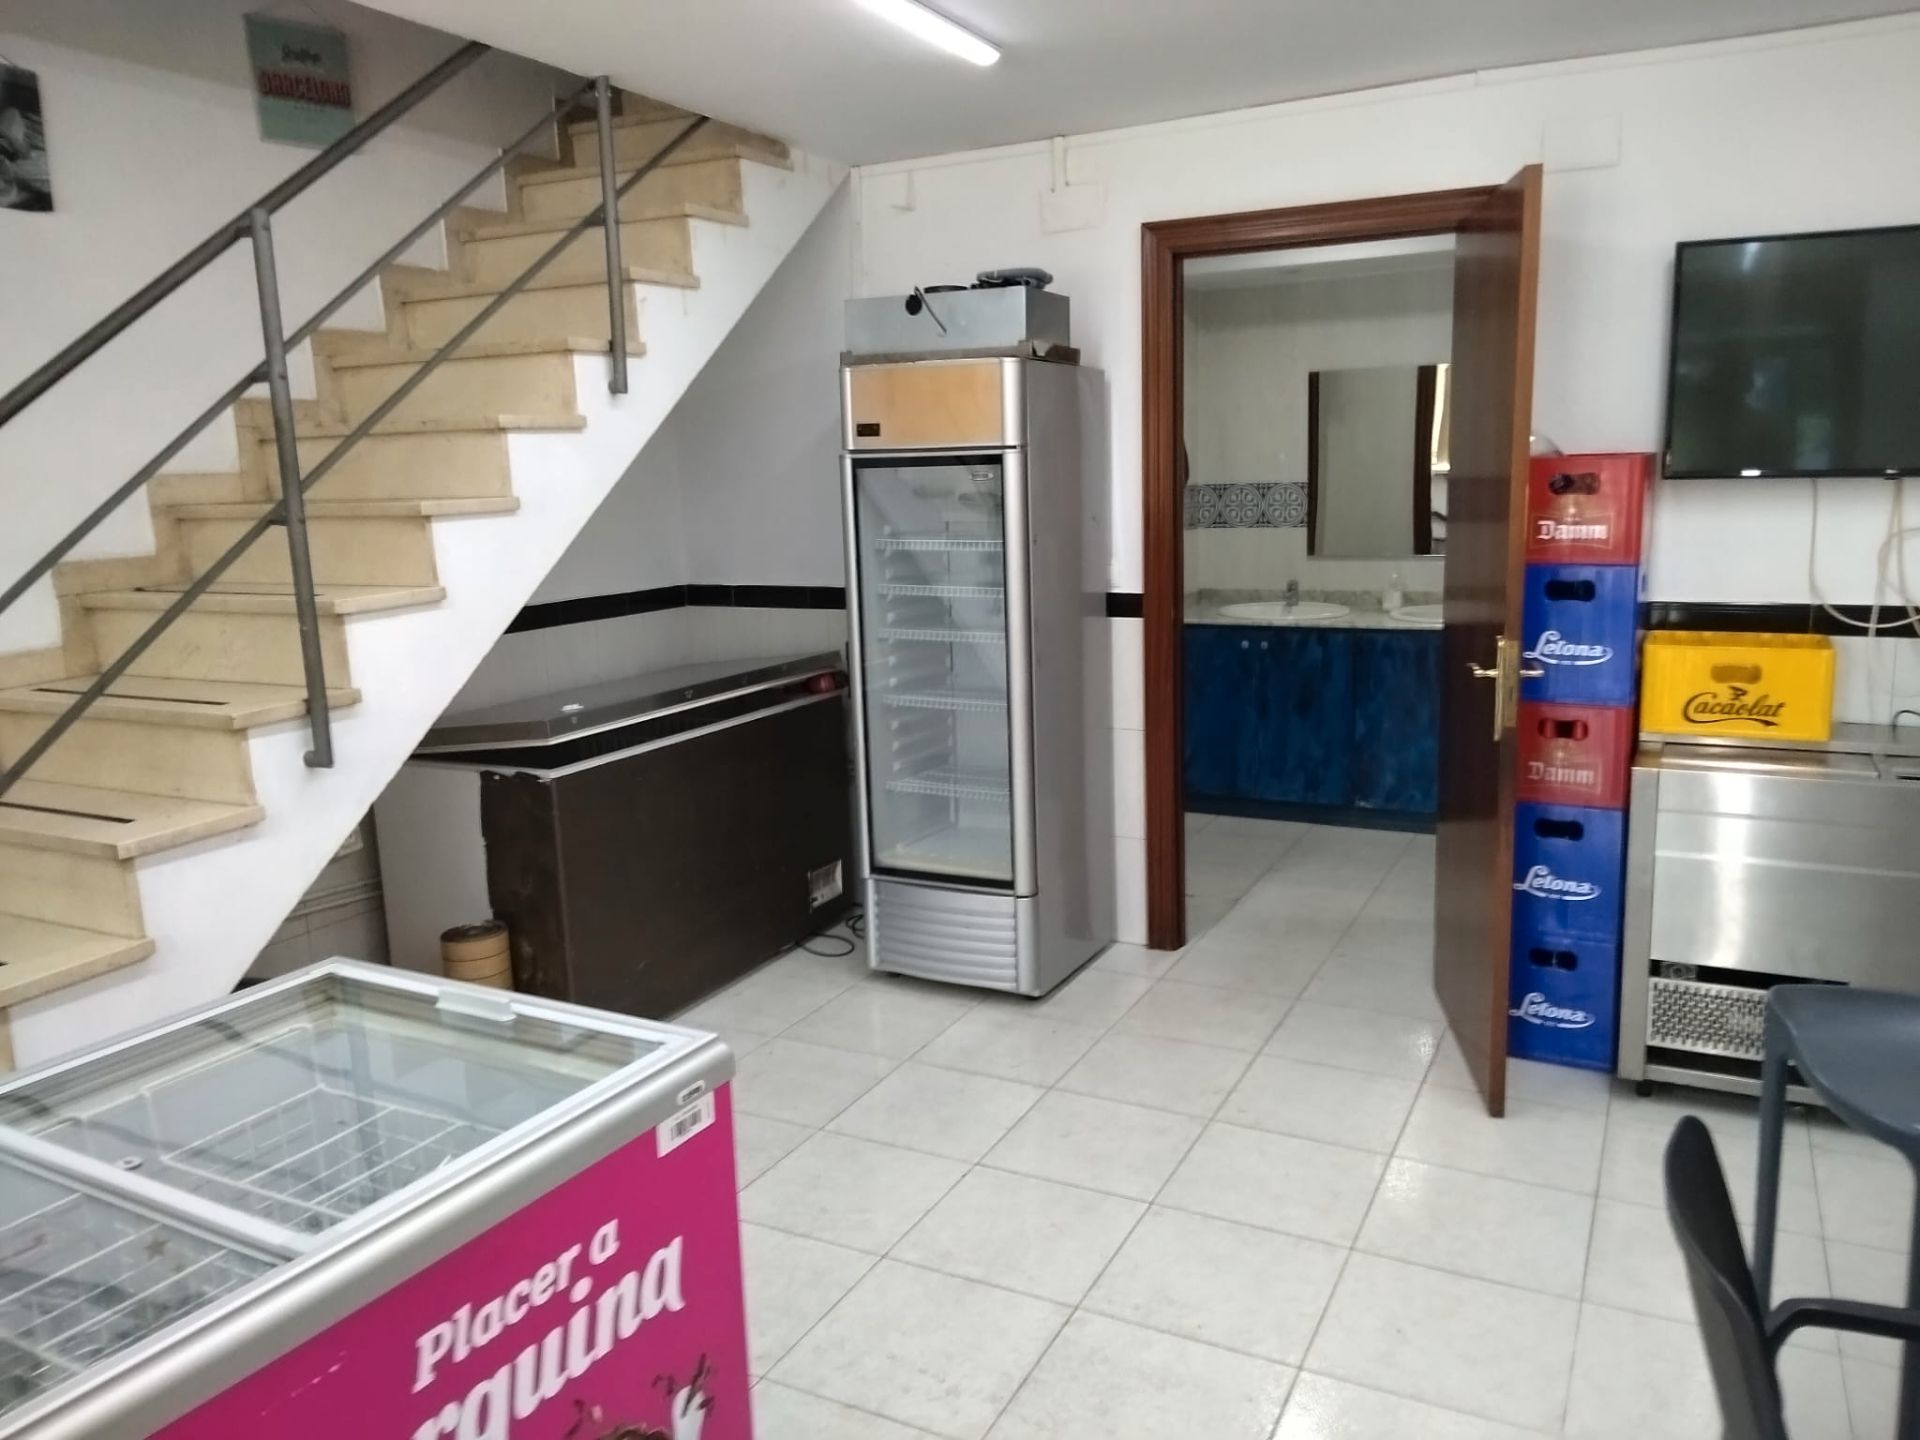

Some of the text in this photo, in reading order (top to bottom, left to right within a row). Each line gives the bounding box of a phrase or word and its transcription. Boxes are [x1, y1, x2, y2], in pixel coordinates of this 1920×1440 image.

[1536, 519, 1609, 540] Damm
[1522, 631, 1613, 665] Letona
[1682, 691, 1786, 726] Cacaolat
[1528, 761, 1595, 785] Damm
[1513, 865, 1601, 900] Letona
[1508, 992, 1596, 1028] Letona
[412, 1218, 620, 1394] Placer a
